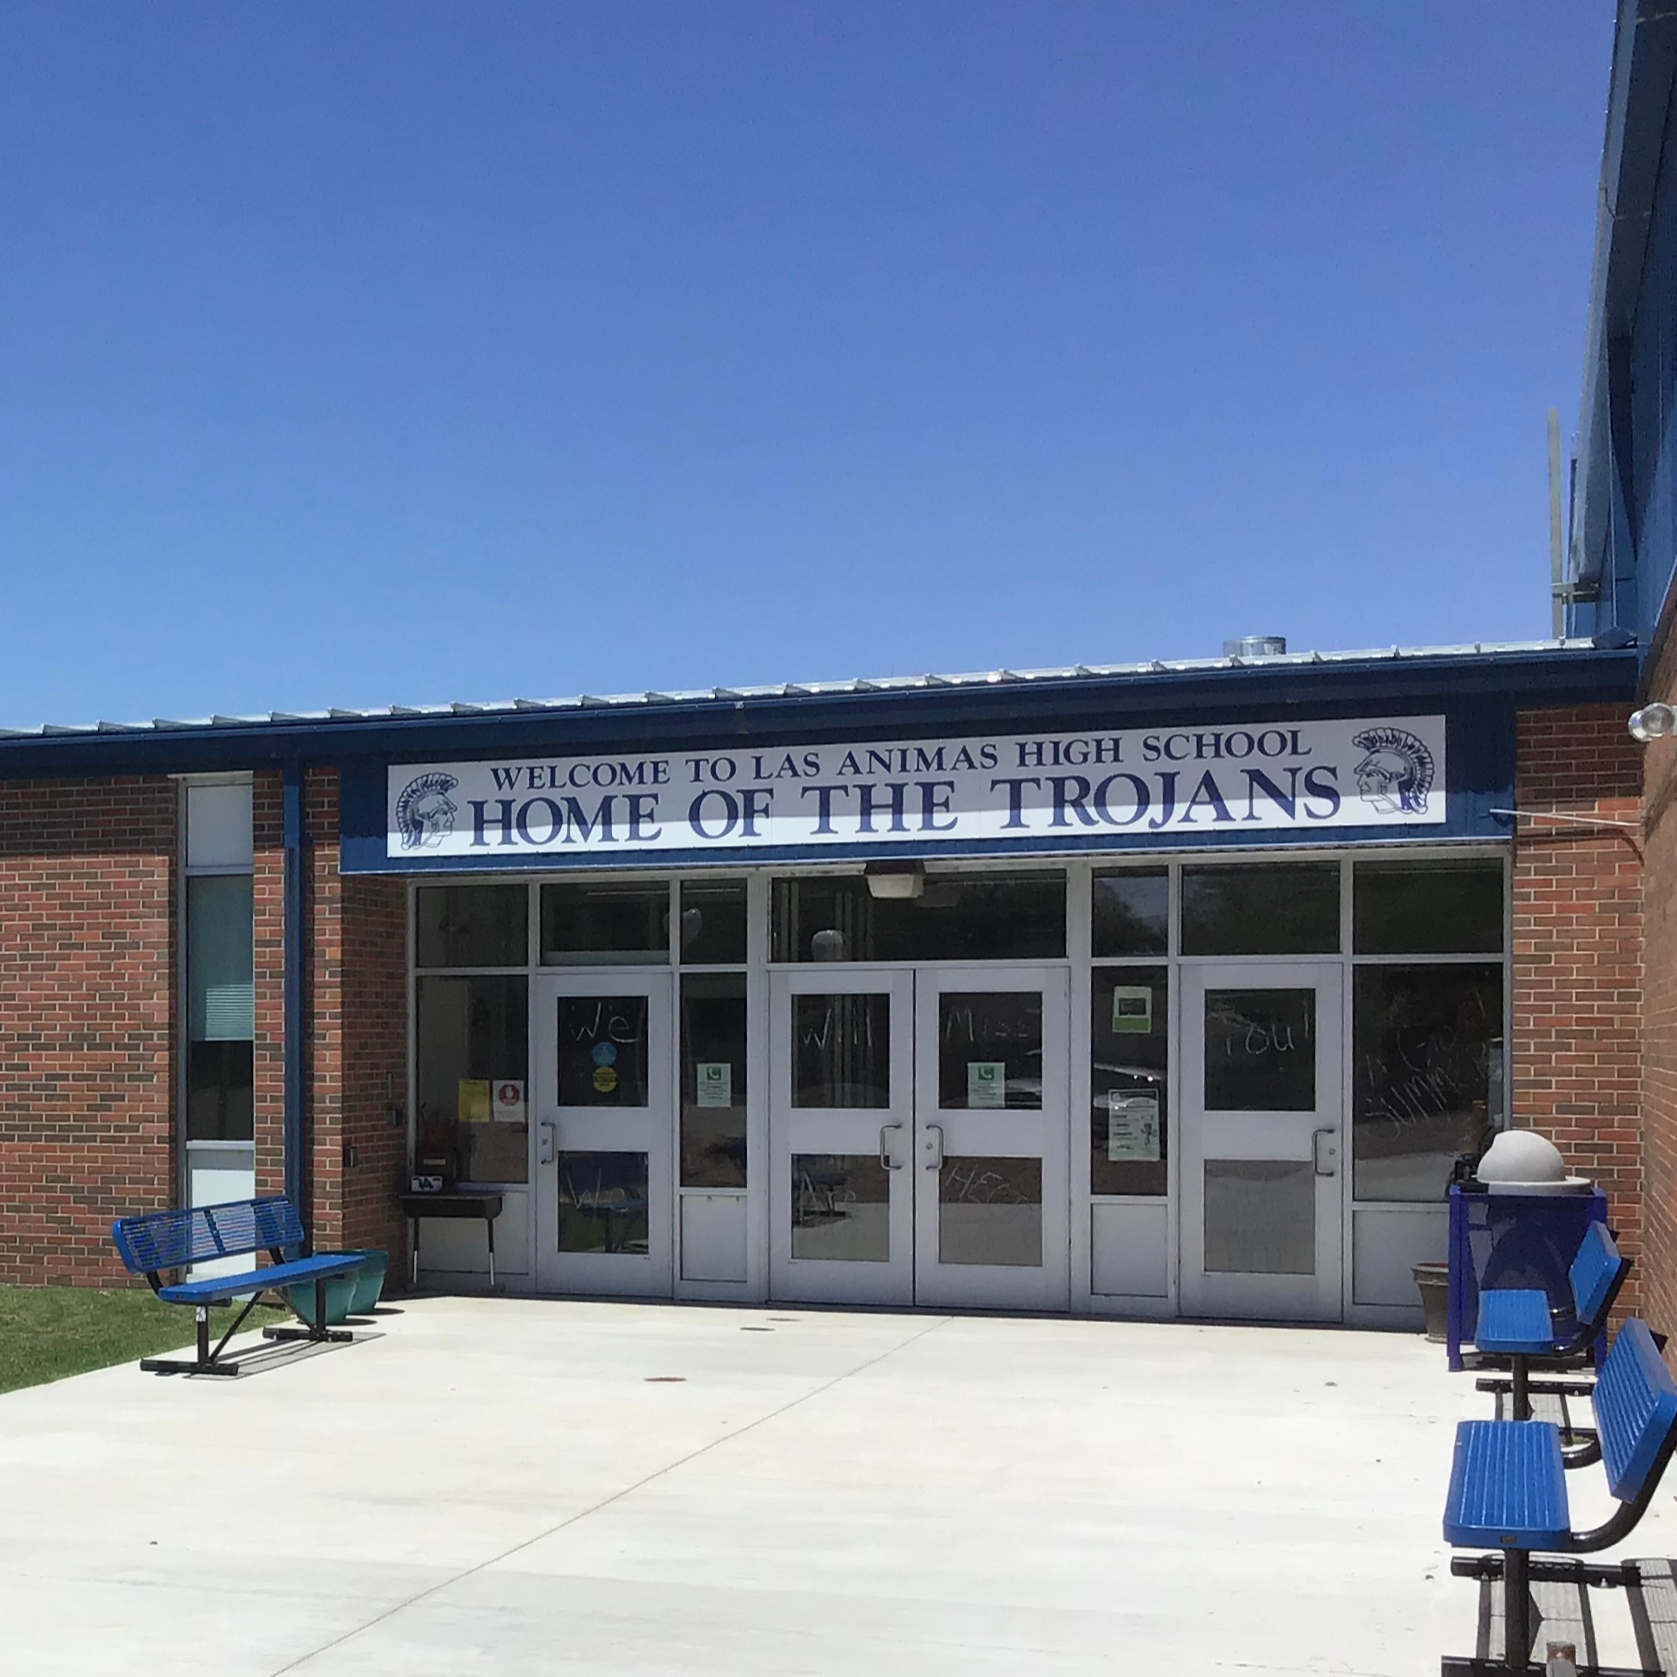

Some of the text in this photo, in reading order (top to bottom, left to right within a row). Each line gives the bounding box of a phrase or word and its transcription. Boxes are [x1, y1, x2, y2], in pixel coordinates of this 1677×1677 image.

[491, 729, 1313, 791] WELCOME TO LAS ANIMAS HIGH SCHOOL
[466, 765, 1341, 847] HOME OF THE TROJANS
